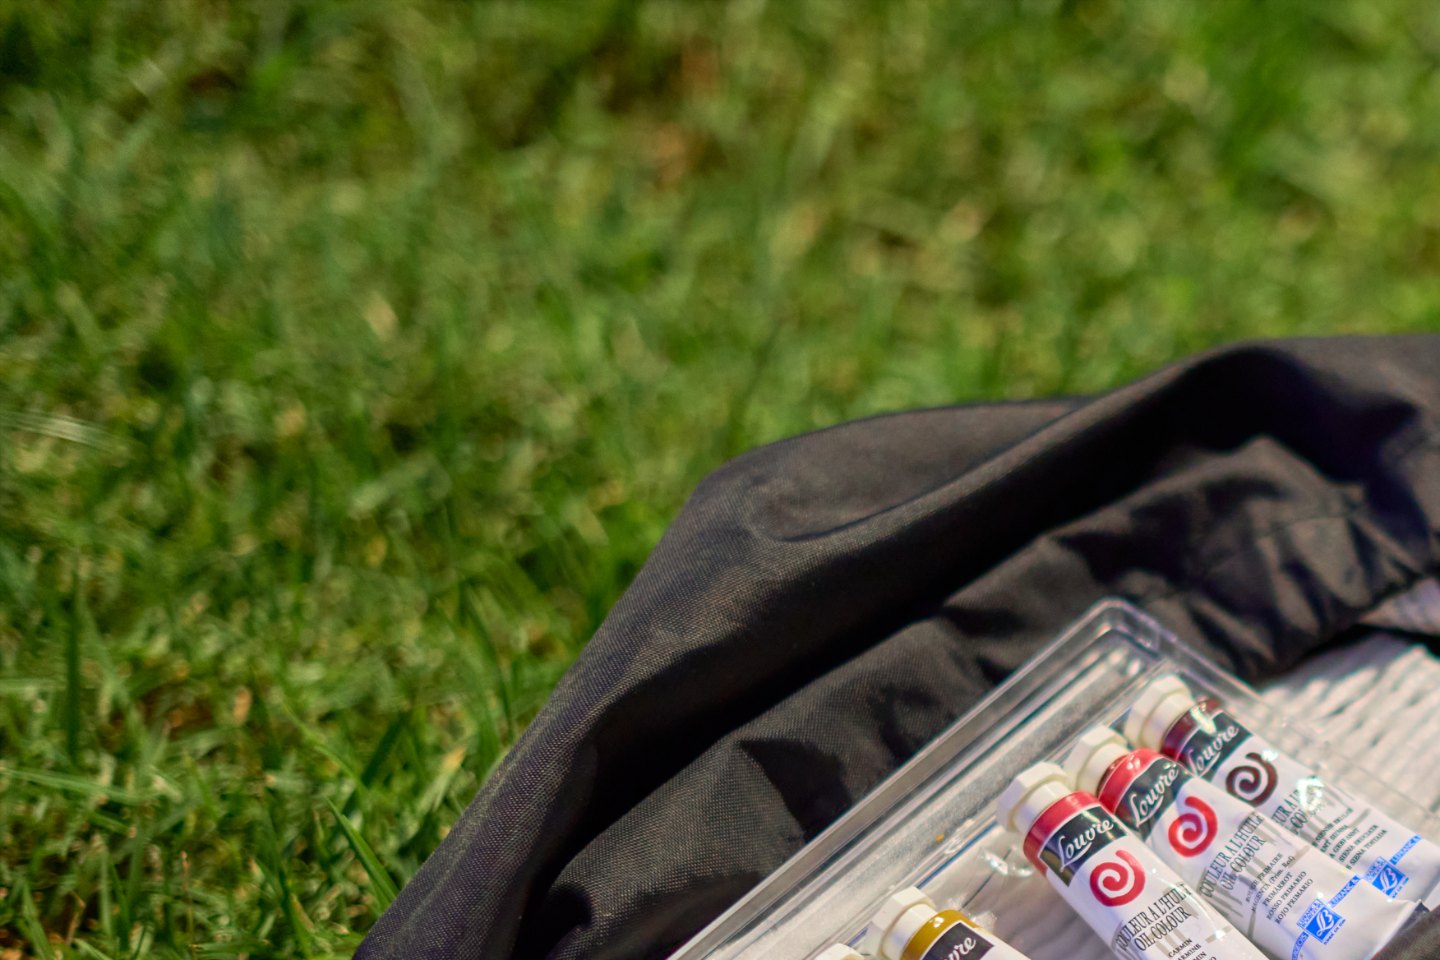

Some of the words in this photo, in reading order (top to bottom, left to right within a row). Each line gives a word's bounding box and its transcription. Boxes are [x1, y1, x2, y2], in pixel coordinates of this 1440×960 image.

[1187, 724, 1239, 775] Louvre
[1129, 768, 1178, 827] Louvre
[1057, 819, 1113, 872] Louvre
[1199, 854, 1231, 896] COULEUR
[1224, 843, 1237, 856] A
[1229, 835, 1266, 872] COLOUR
[1145, 905, 1160, 920] A
[1266, 898, 1282, 920] ROSSO
[1280, 869, 1307, 900] PRIMARIO
[1274, 906, 1289, 923] ROJO
[1286, 877, 1313, 908] PRIMARIO
[1132, 931, 1156, 952] OIL
[1149, 906, 1191, 938] COLOUR
[1167, 937, 1192, 958] CARMIN
